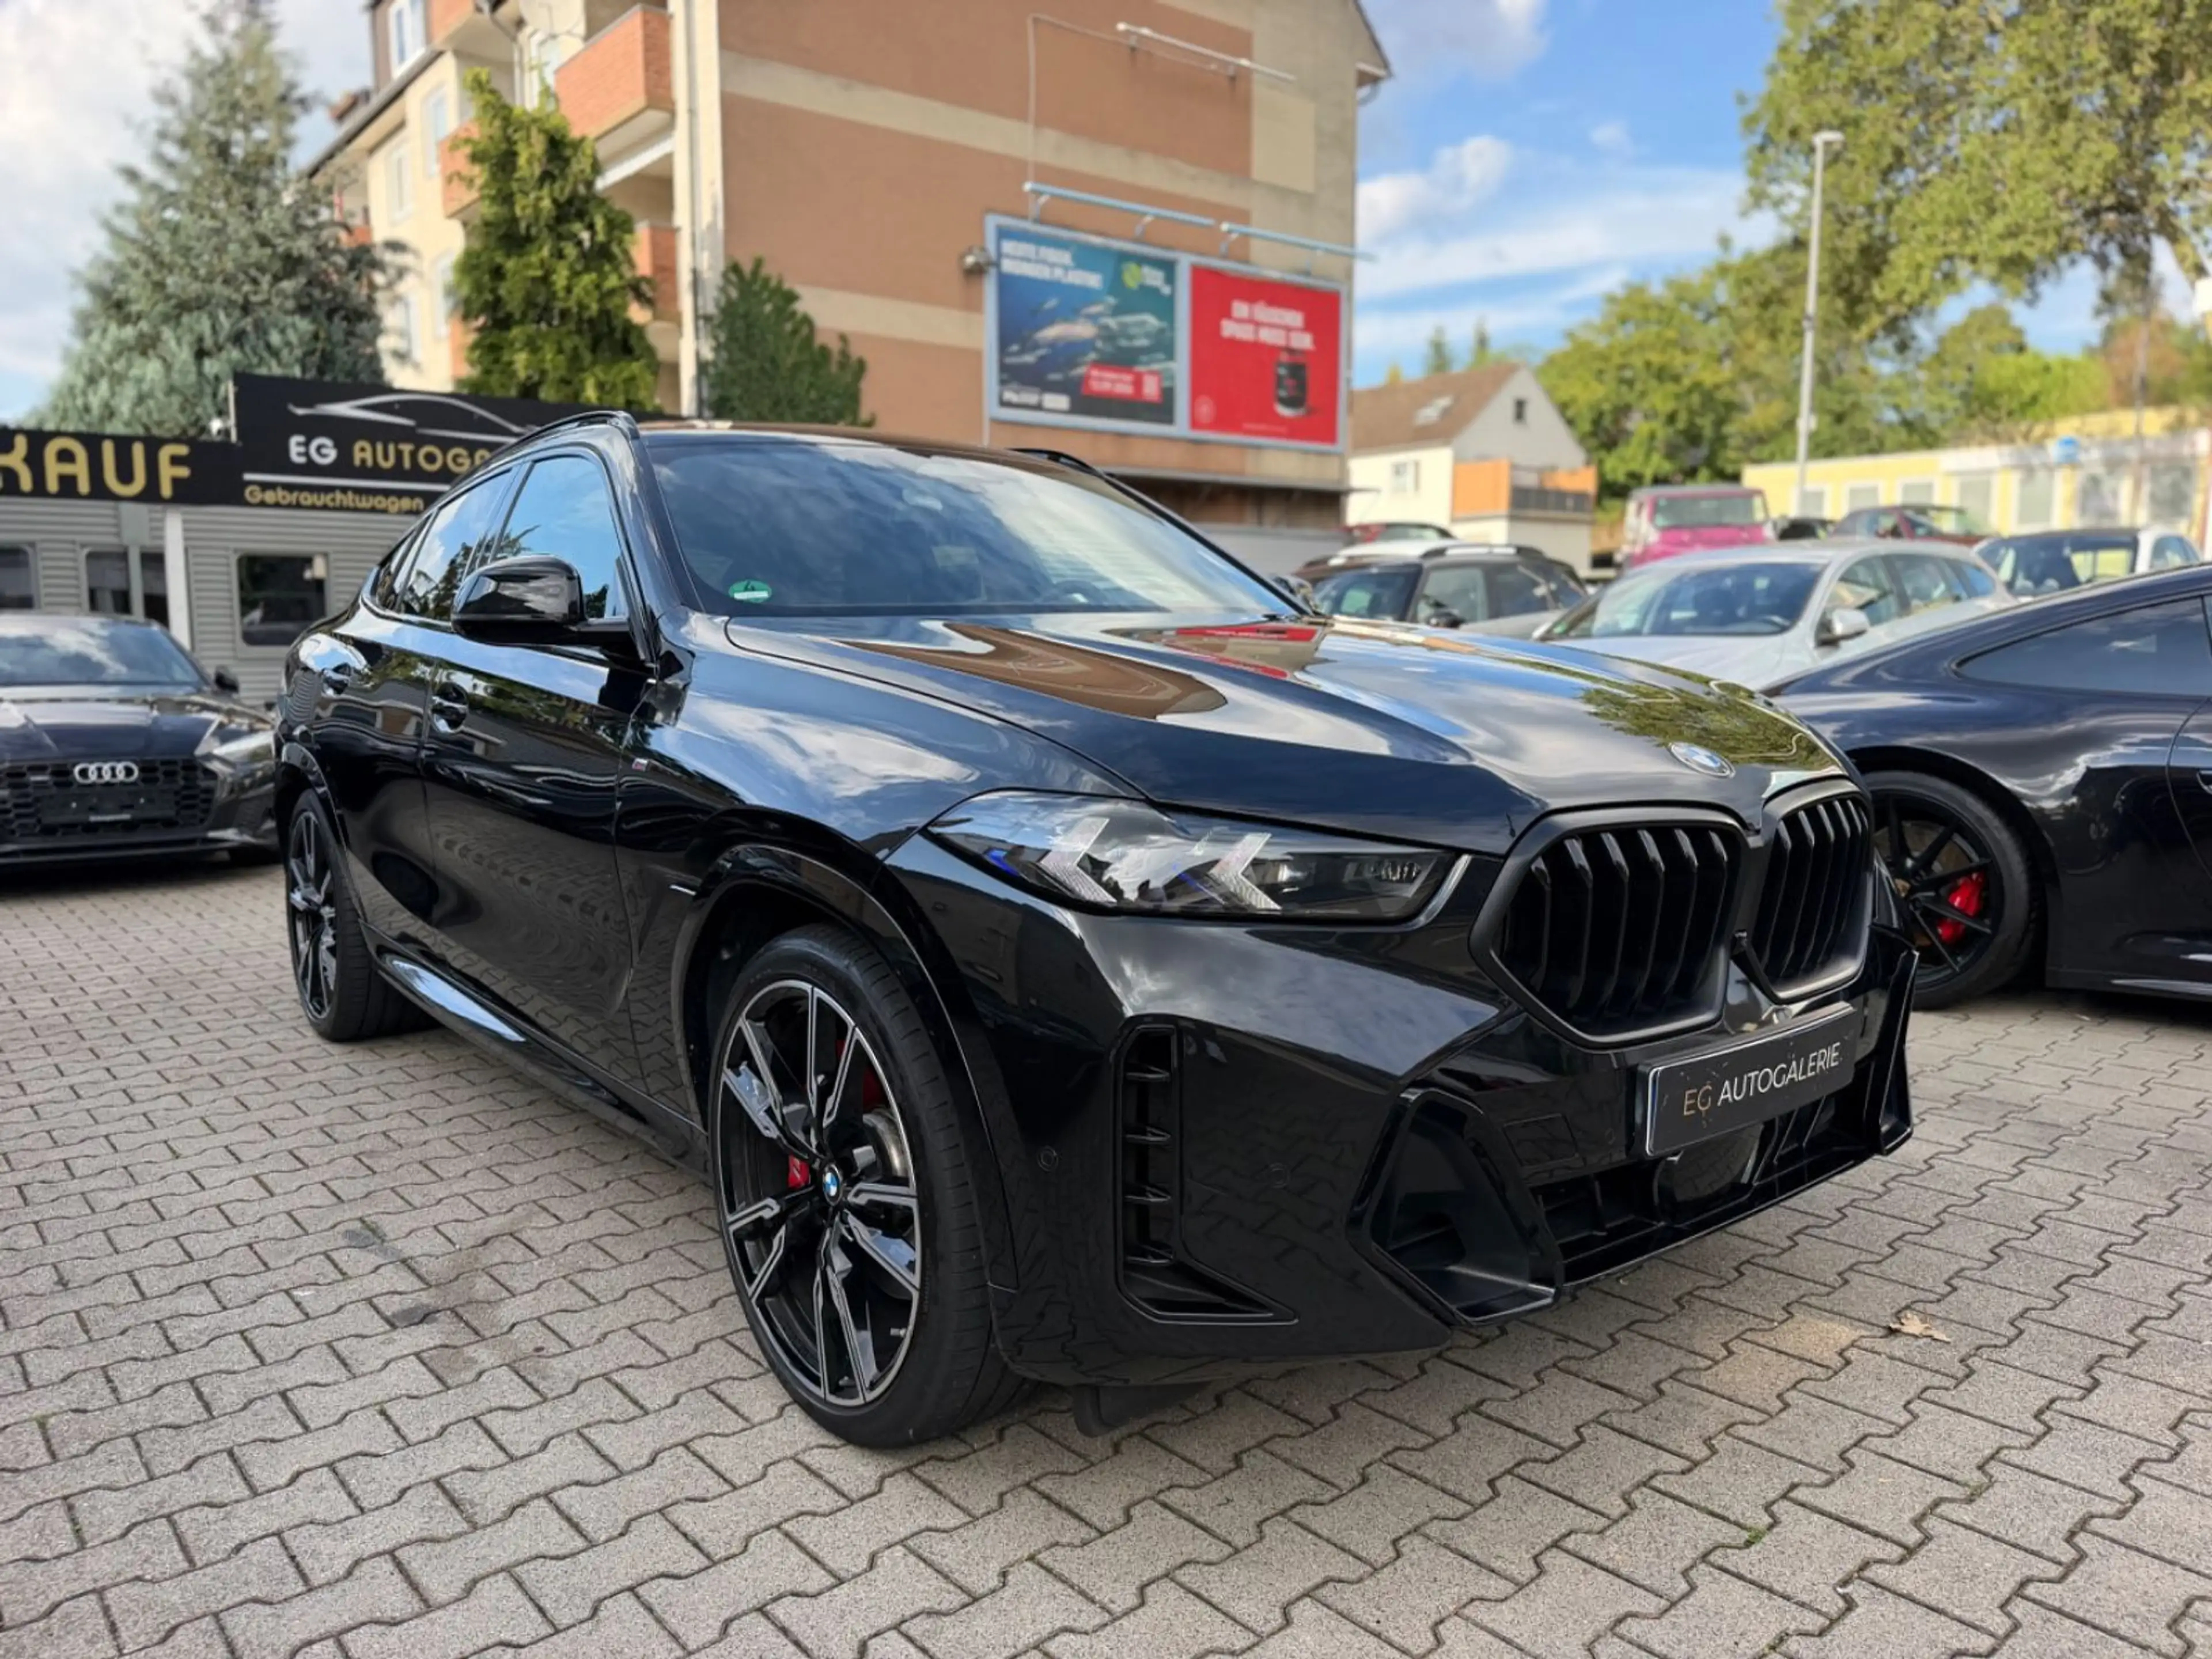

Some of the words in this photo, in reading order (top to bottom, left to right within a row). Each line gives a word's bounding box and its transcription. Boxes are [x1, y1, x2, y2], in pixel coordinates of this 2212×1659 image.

[289, 434, 338, 465] EG
[244, 484, 425, 513] Gebrauchtwagen
[1683, 1084, 1713, 1116] EG
[1717, 1041, 1841, 1107] AUTOGALERIE
